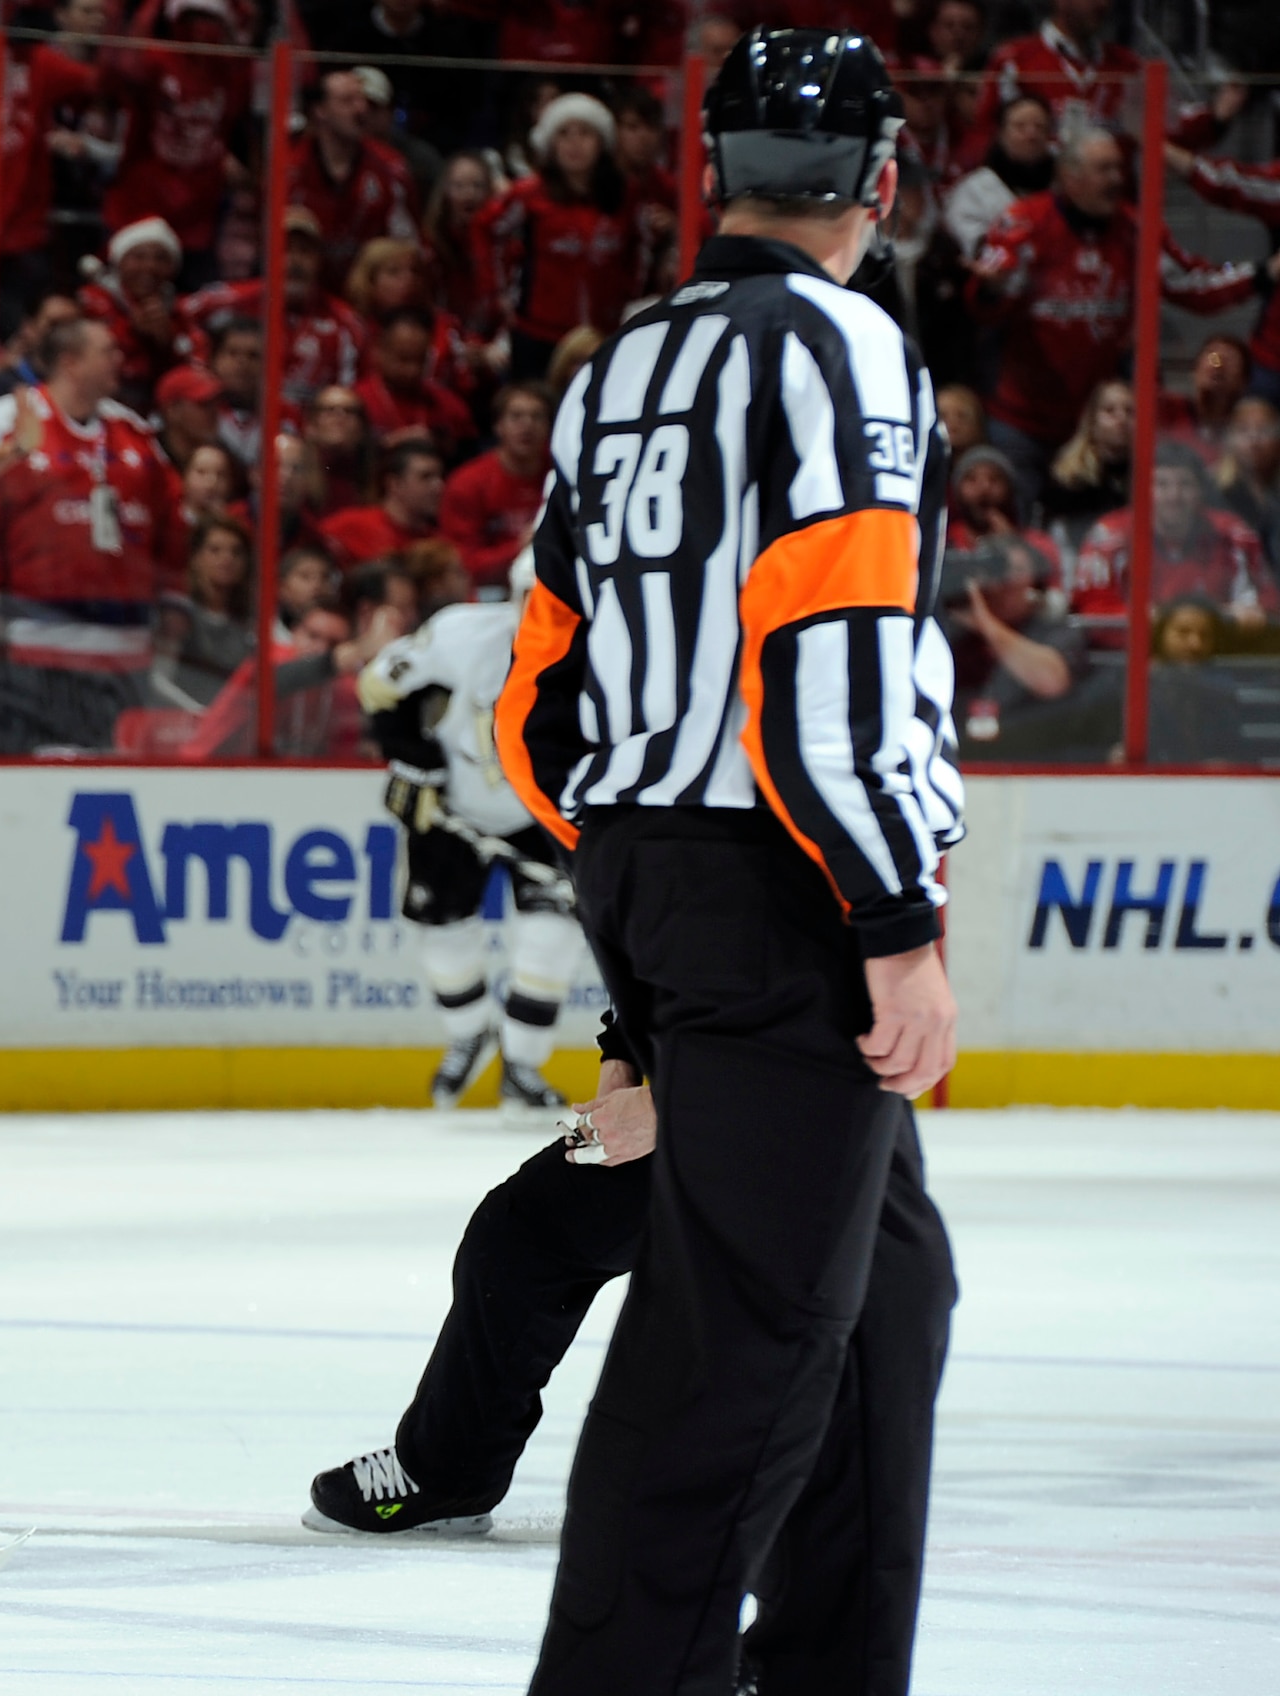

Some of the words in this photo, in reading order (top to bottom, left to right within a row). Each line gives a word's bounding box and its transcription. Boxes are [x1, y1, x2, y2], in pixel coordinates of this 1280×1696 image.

[585, 423, 690, 566] 38
[1028, 861, 1280, 949] NHL.
[53, 968, 124, 1009] Your
[135, 969, 312, 1008] Hometown
[328, 969, 419, 1008] Place
